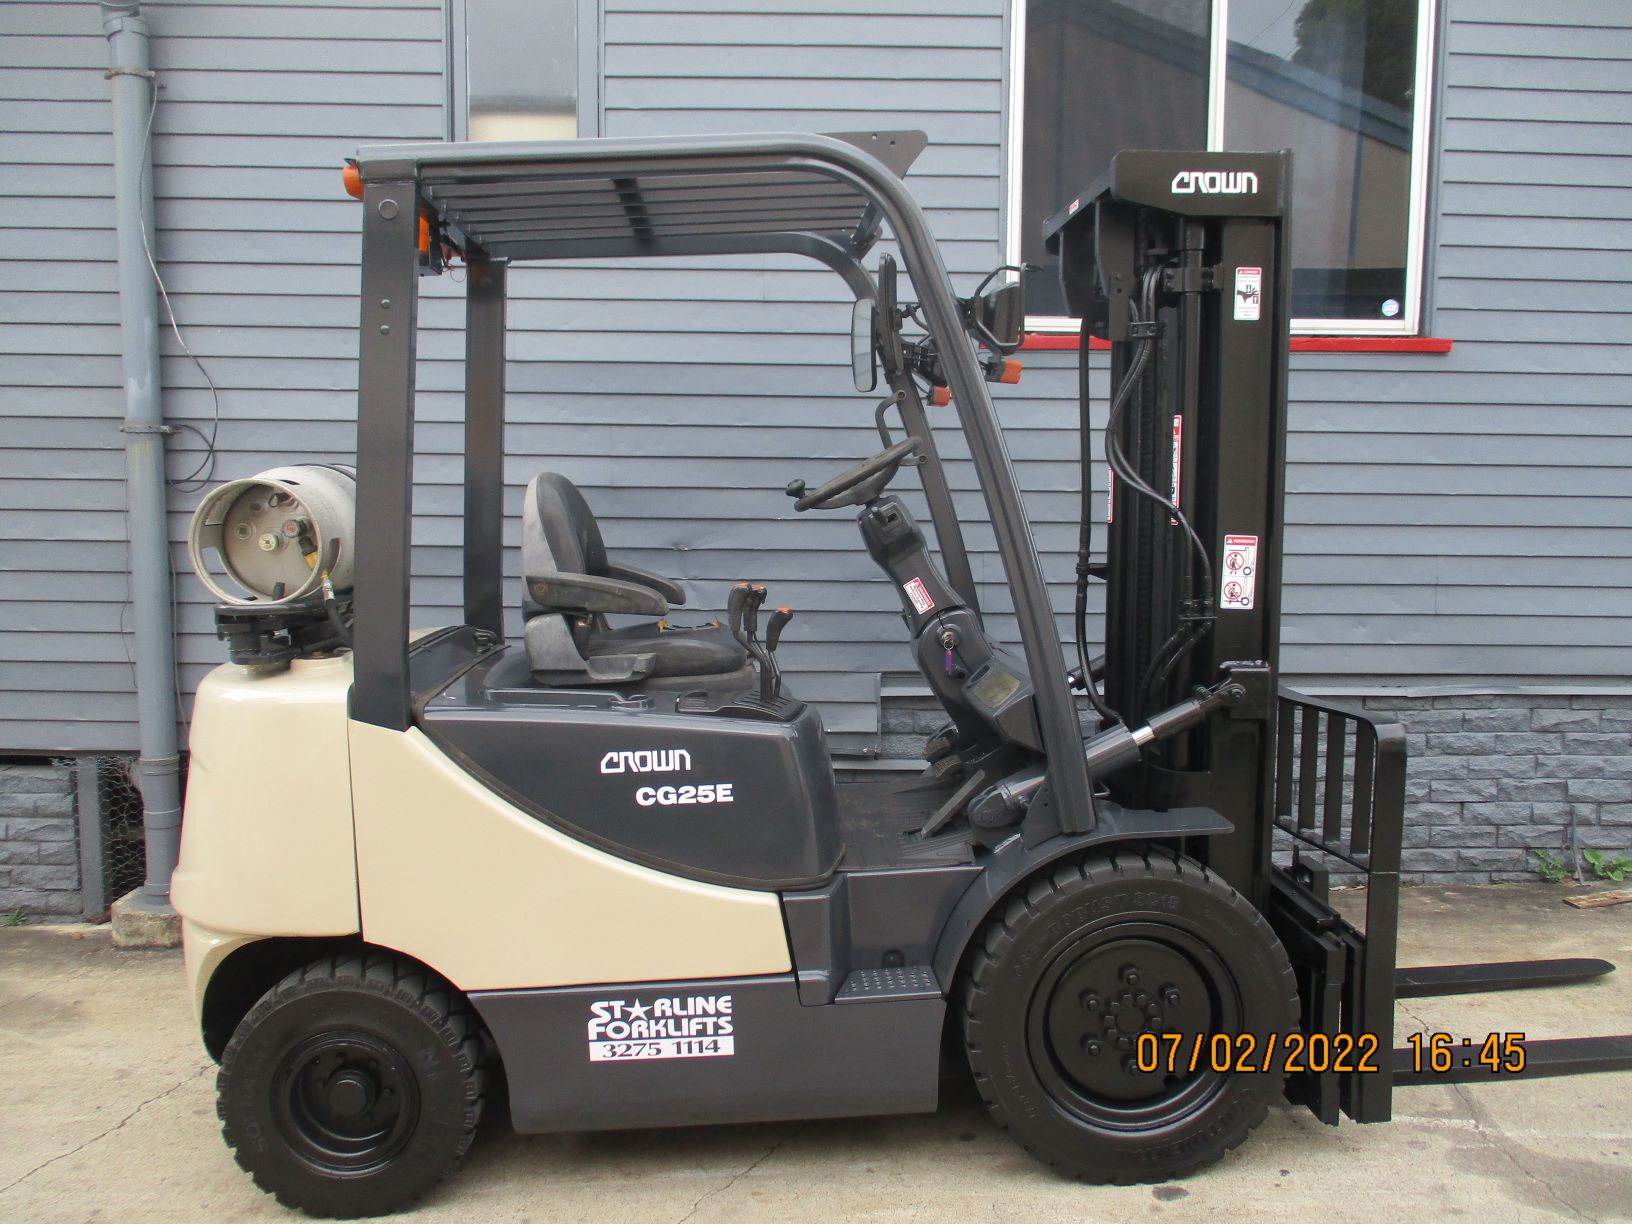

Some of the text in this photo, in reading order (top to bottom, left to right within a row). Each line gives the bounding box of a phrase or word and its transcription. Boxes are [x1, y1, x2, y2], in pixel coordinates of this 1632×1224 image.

[1171, 171, 1259, 194] CROWN
[600, 749, 692, 774] CROWN
[635, 783, 734, 806] CG25E
[588, 1016, 734, 1040] FORKLIFTS
[602, 1039, 721, 1058] 3275 1114
